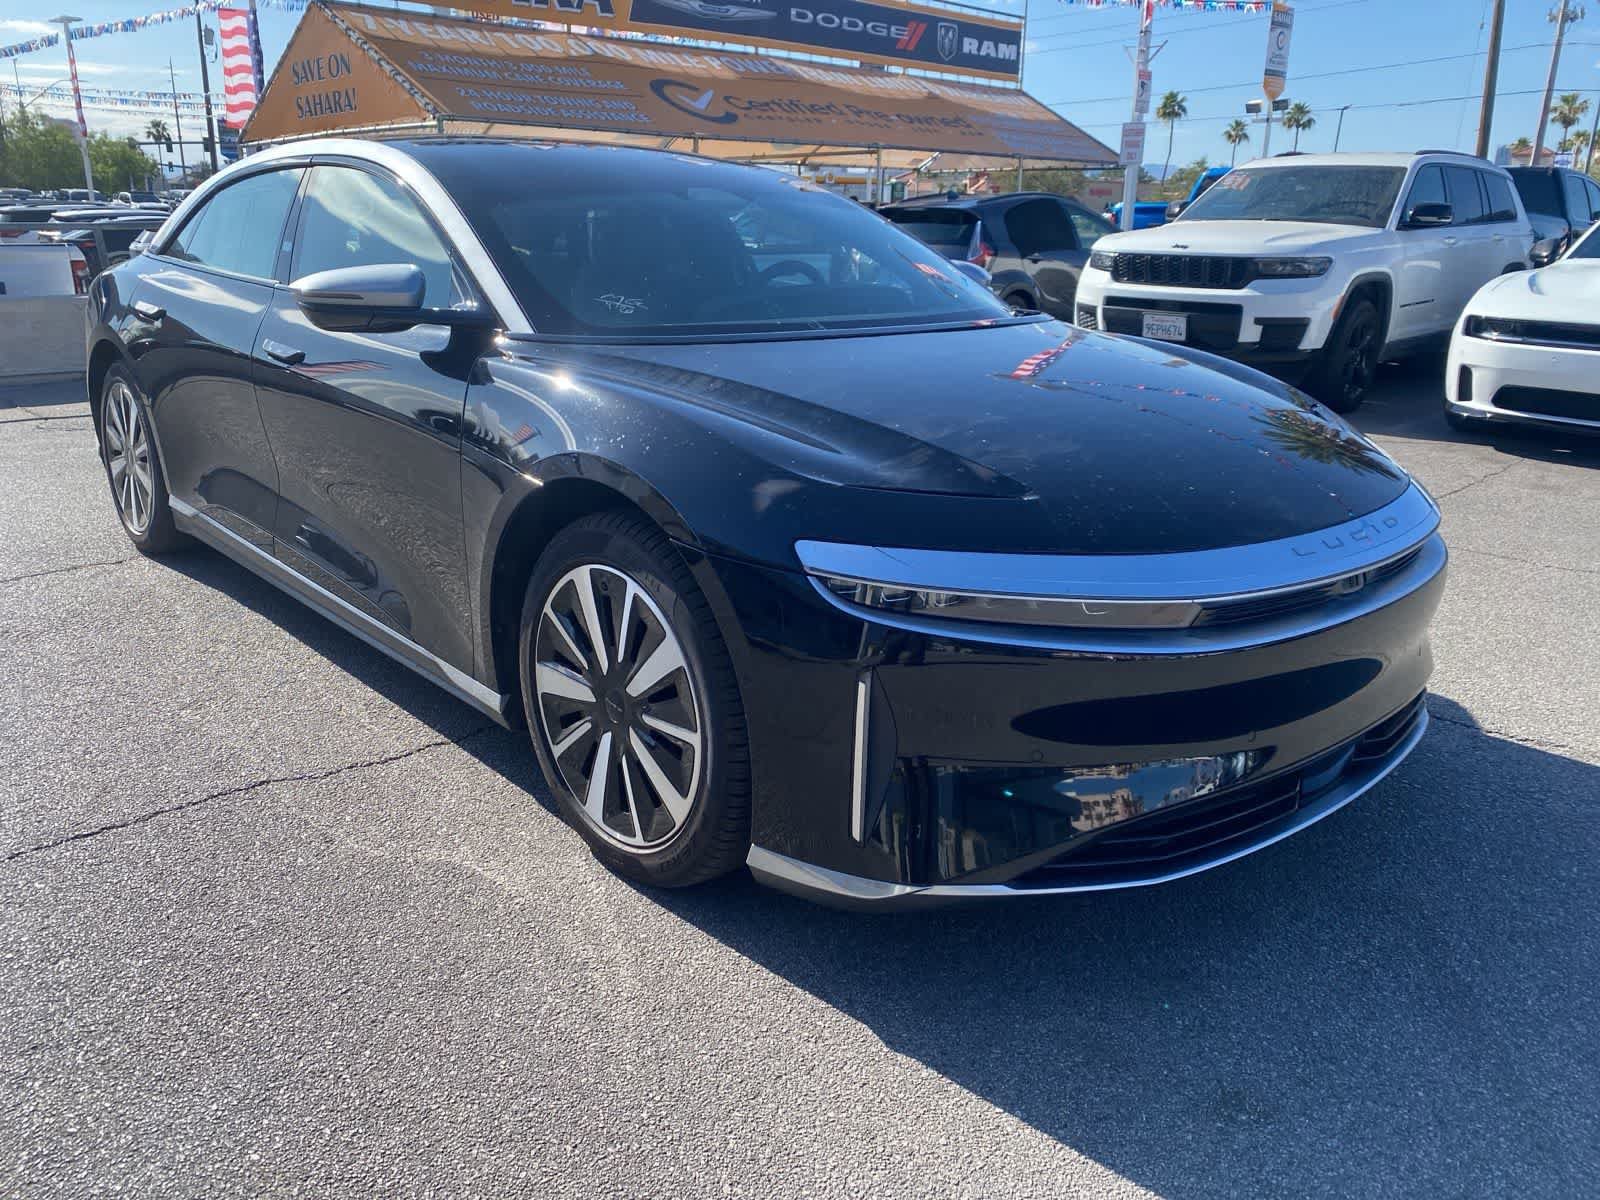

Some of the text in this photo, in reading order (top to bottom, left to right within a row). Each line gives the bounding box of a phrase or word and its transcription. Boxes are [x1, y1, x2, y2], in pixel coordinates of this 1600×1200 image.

[790, 7, 908, 40] DODGE
[962, 36, 1018, 61] RAM
[292, 53, 352, 86] SAVE ON
[296, 87, 358, 119] SAHARA!
[722, 95, 843, 116] Certified
